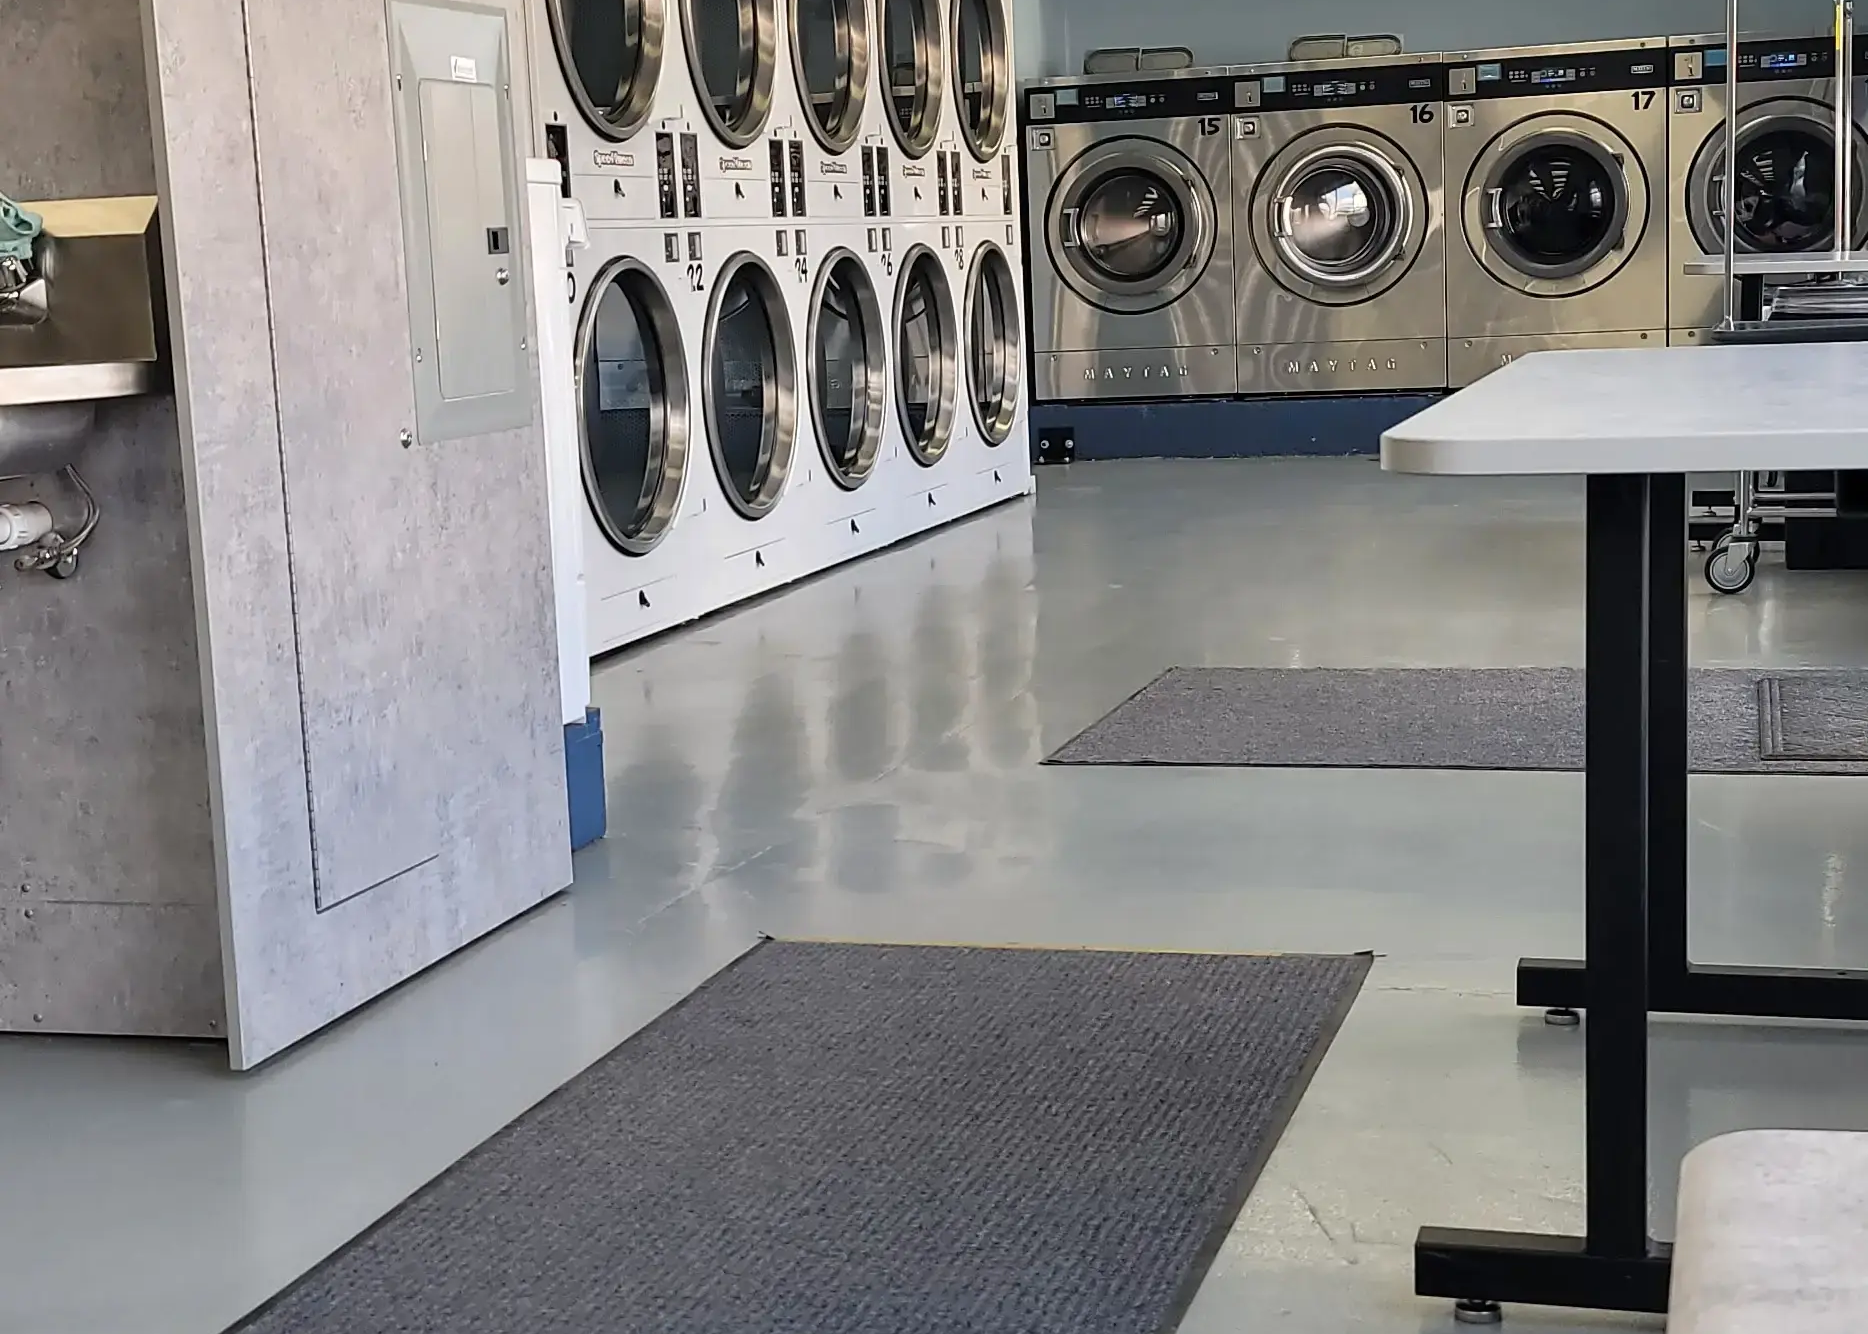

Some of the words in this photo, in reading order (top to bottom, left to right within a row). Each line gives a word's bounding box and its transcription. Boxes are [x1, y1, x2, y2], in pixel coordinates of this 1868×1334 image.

[1630, 90, 1656, 111] 17
[1409, 103, 1435, 124] 16
[1198, 117, 1222, 136] 15
[686, 263, 705, 292] 22
[1288, 358, 1397, 373] MAYTAG
